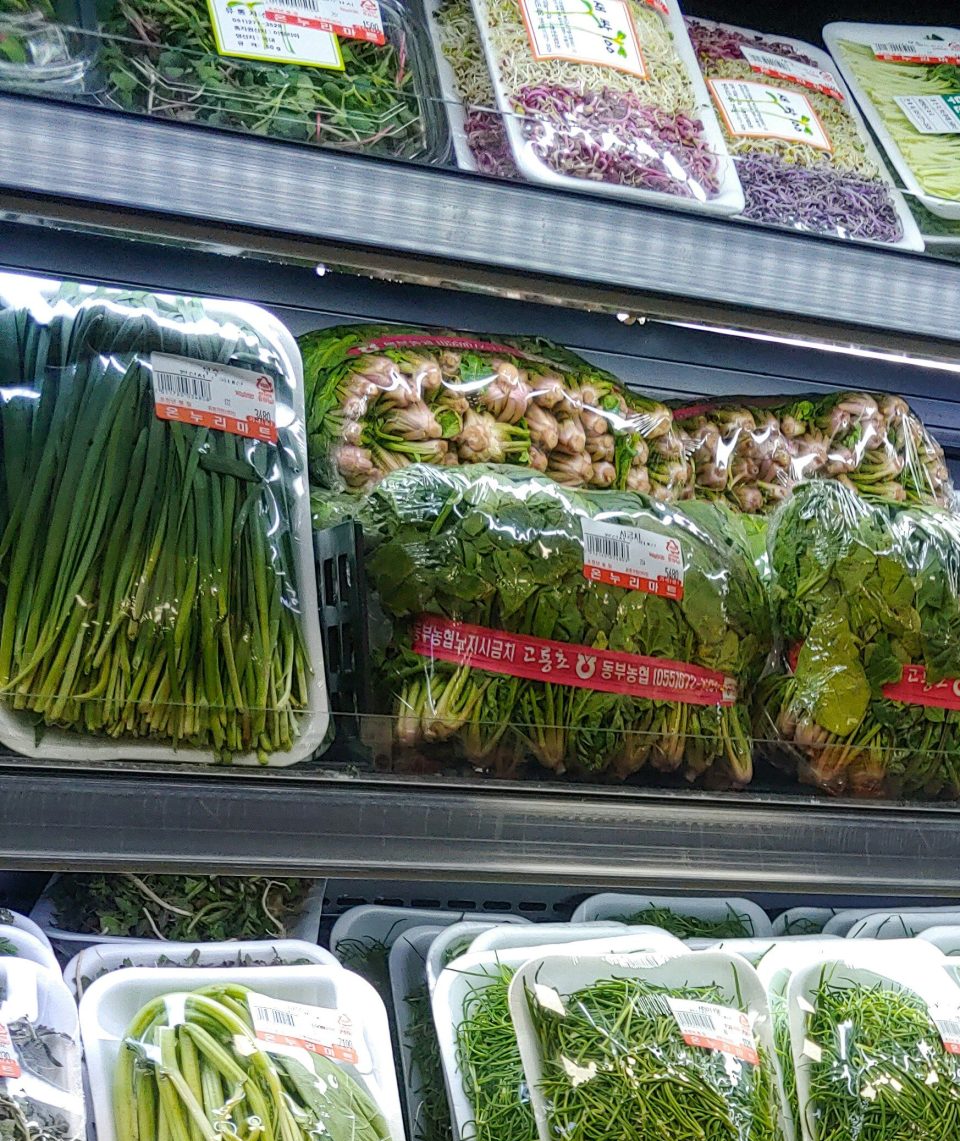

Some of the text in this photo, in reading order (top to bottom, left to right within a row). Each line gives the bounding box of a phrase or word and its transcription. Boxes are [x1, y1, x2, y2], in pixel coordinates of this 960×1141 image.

[165, 406, 271, 439] 온누리마트
[591, 568, 677, 597] 온누리마트
[601, 660, 650, 686] 동부농협
